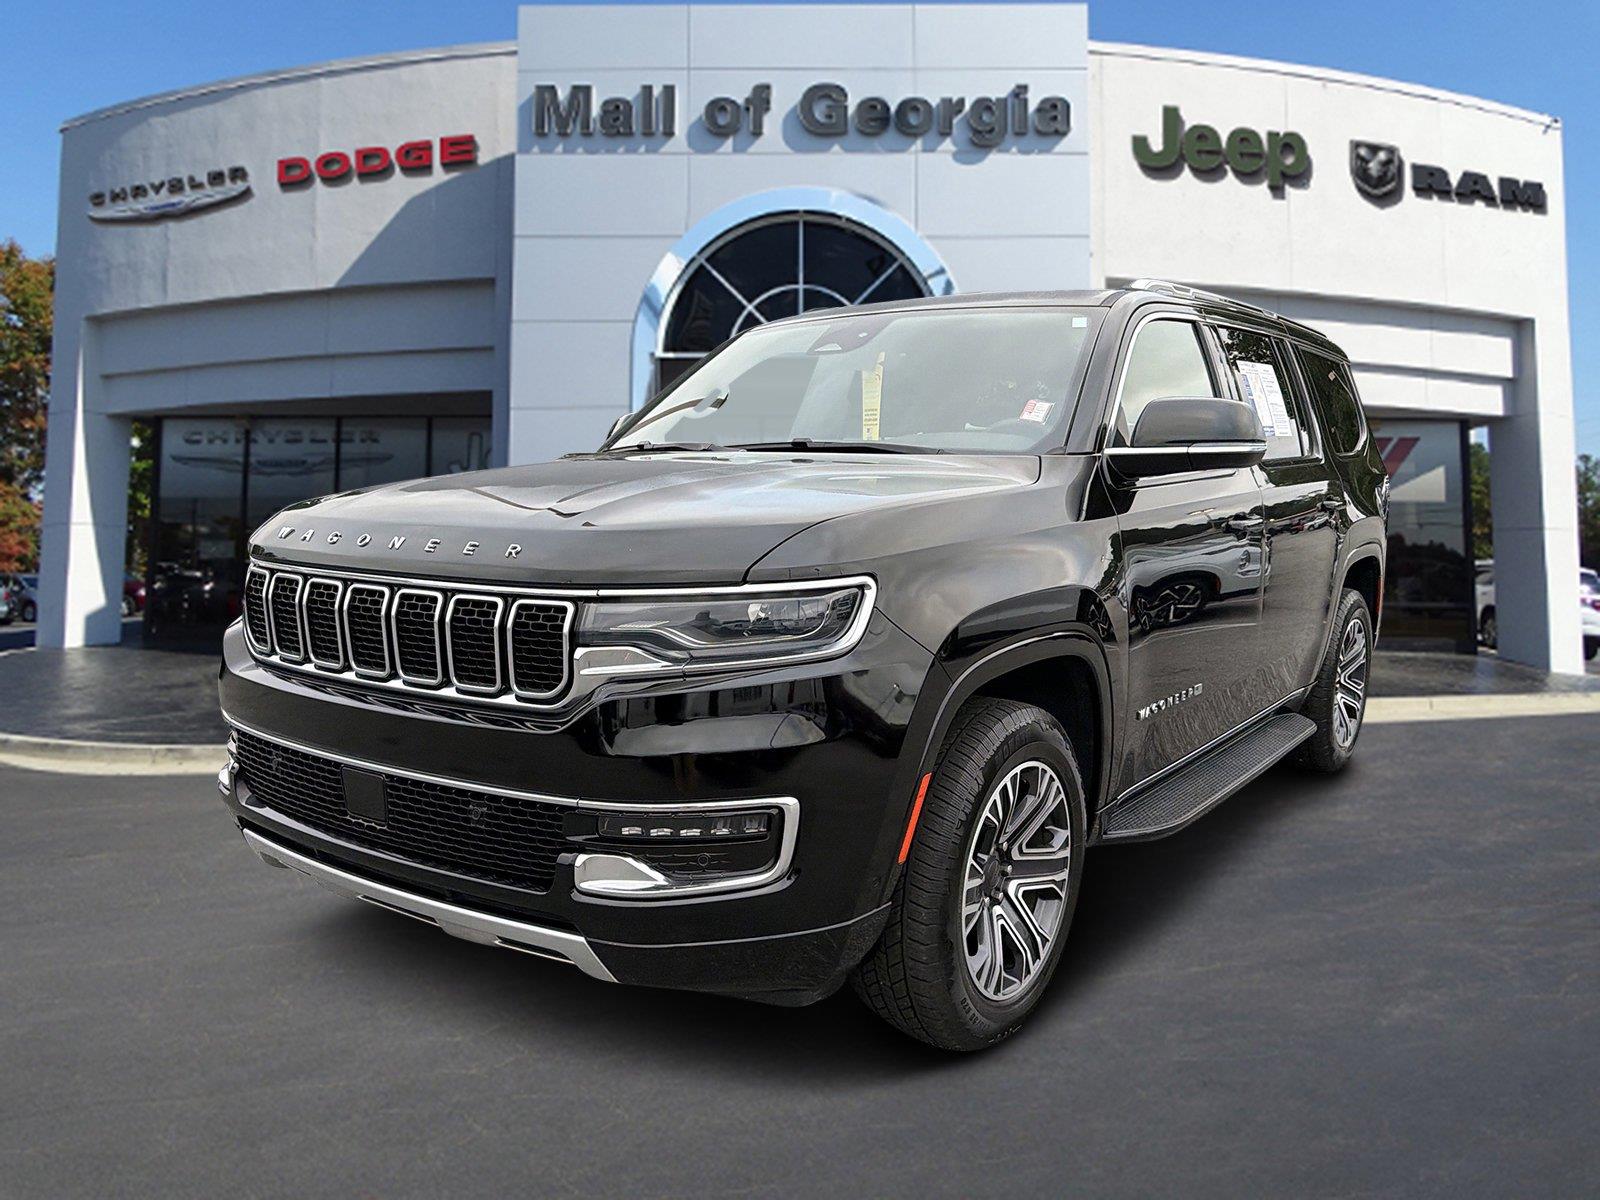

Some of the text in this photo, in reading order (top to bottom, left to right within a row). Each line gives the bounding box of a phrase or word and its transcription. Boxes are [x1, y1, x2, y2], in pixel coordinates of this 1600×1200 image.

[531, 82, 1073, 149] Mall of Georgia
[276, 134, 479, 188] DODGE
[1131, 105, 1311, 199] Jeep
[88, 165, 250, 207] CHRYSLER
[1411, 162, 1548, 215] RAM
[277, 525, 523, 559] WAGONEER
[1138, 687, 1194, 721] WAGONEER
